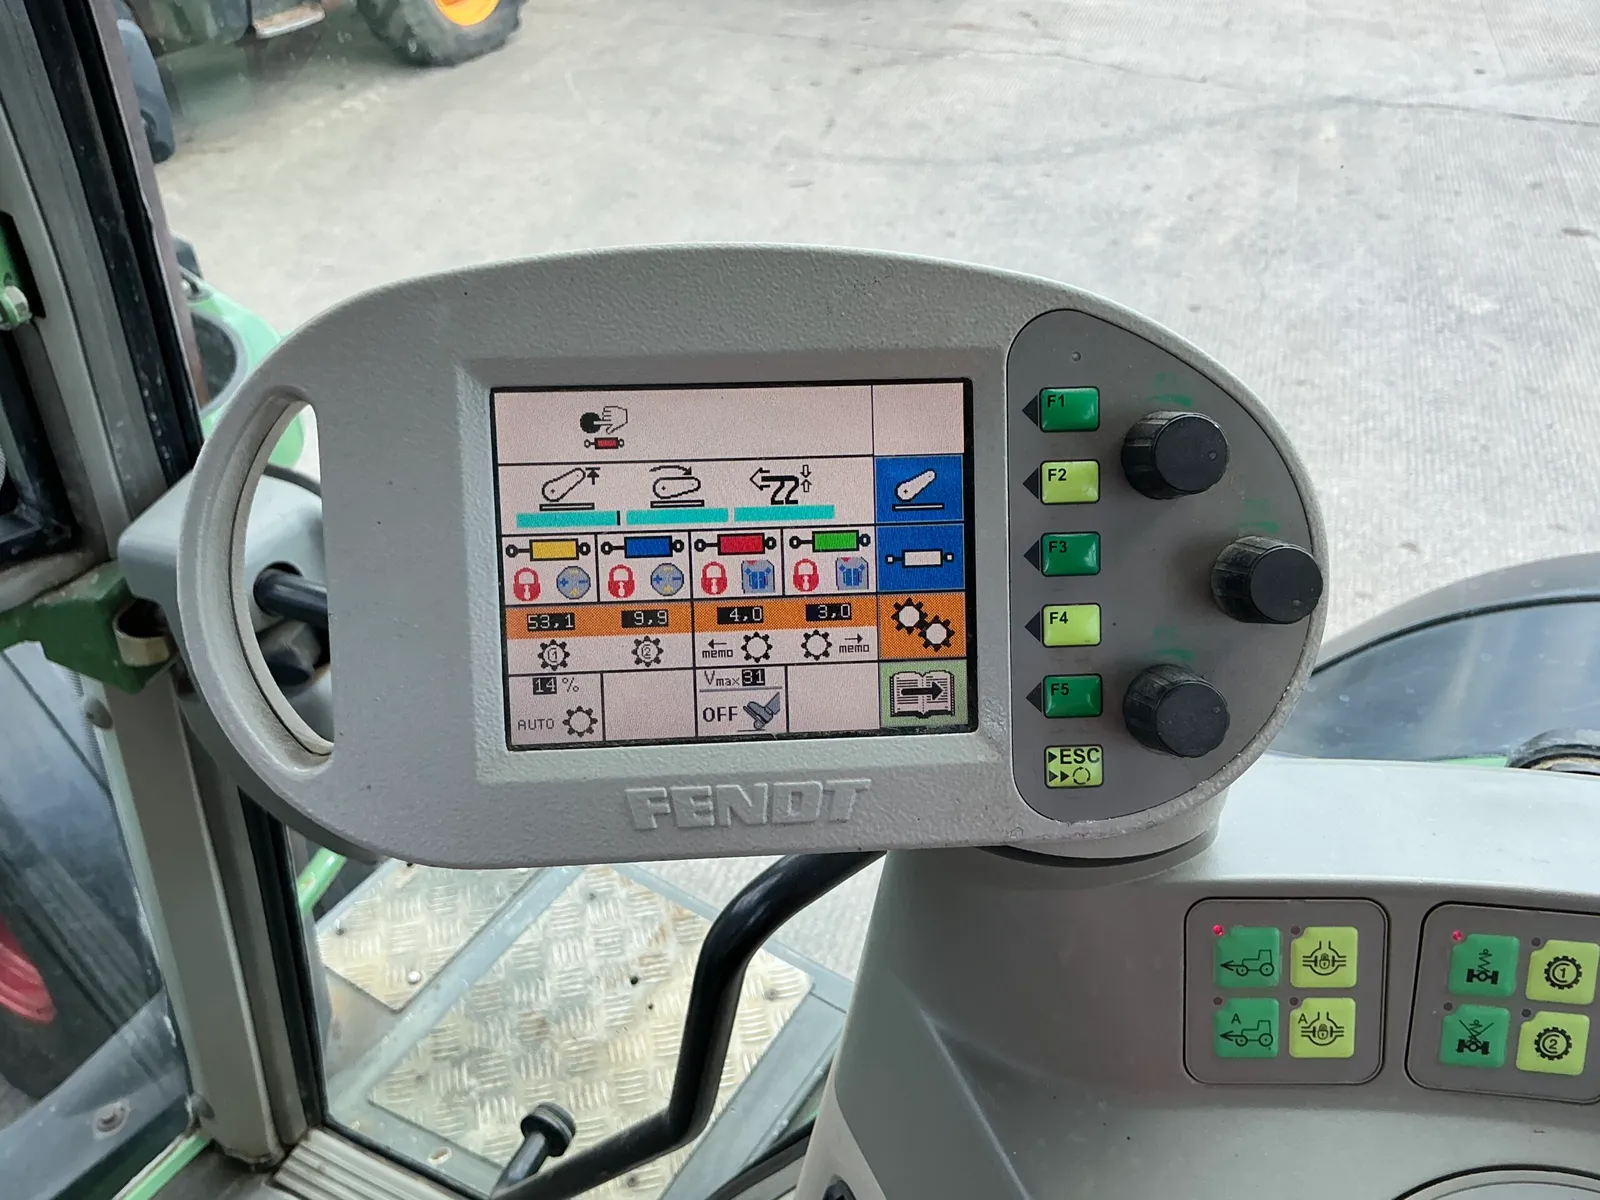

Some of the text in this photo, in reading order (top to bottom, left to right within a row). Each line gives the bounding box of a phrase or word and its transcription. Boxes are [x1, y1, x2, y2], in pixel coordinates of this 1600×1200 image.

[1047, 394, 1065, 408] F1
[1047, 468, 1067, 482] F2
[1048, 541, 1068, 554] F3
[1049, 611, 1069, 625] F4
[701, 649, 734, 659] memo
[838, 643, 870, 654] memo
[1050, 682, 1070, 696] F5
[702, 706, 739, 723] OFF
[517, 718, 555, 731] AUTO
[1059, 748, 1101, 765] ESC
[624, 777, 872, 831] FENDT
[1230, 1013, 1242, 1025] A
[1297, 1013, 1309, 1025] A
